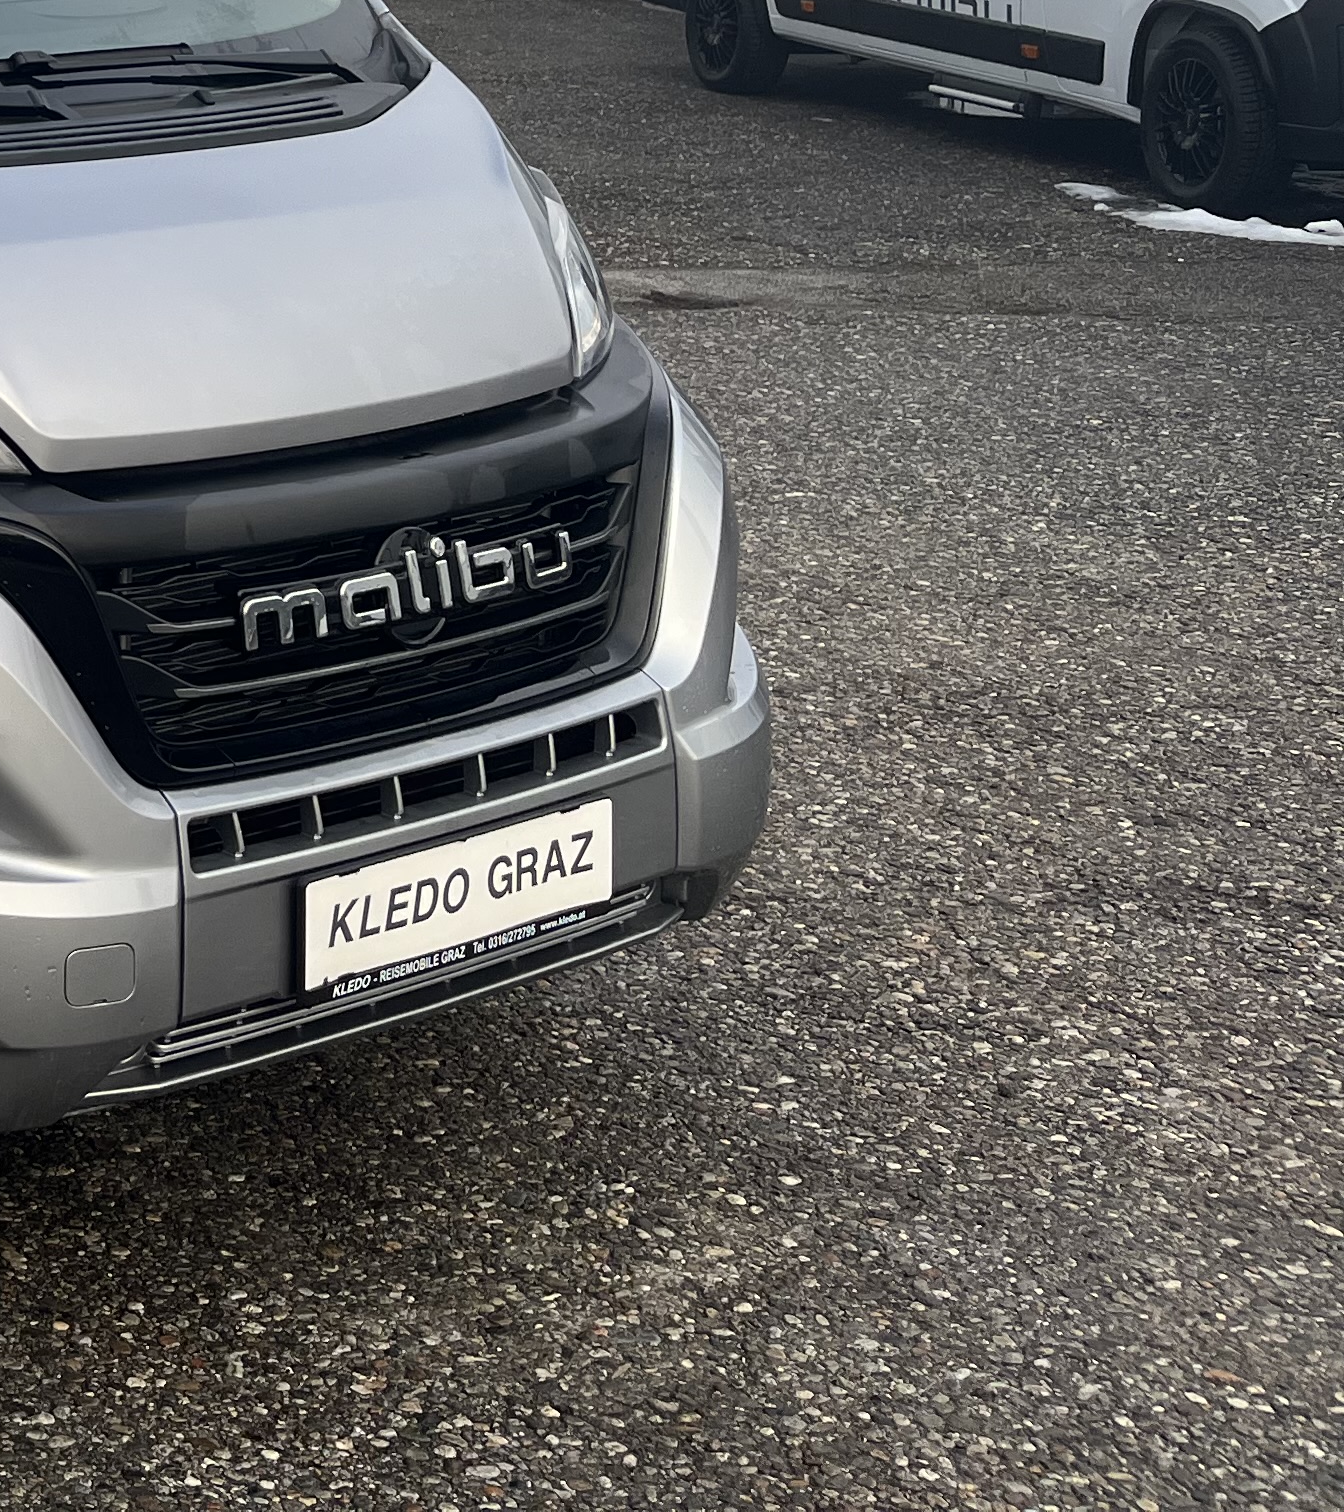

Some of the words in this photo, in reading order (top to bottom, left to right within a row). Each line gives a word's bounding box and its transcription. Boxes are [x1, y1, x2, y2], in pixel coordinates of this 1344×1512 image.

[242, 531, 572, 652] malibu
[328, 867, 470, 949] KLEDO
[487, 830, 594, 899] GRAZ
[332, 974, 371, 998] KLEDO
[379, 955, 440, 983] REISEMOBILE
[441, 945, 466, 964] GRAZ
[472, 941, 487, 954] Tel.
[488, 924, 536, 949] 0316/272795
